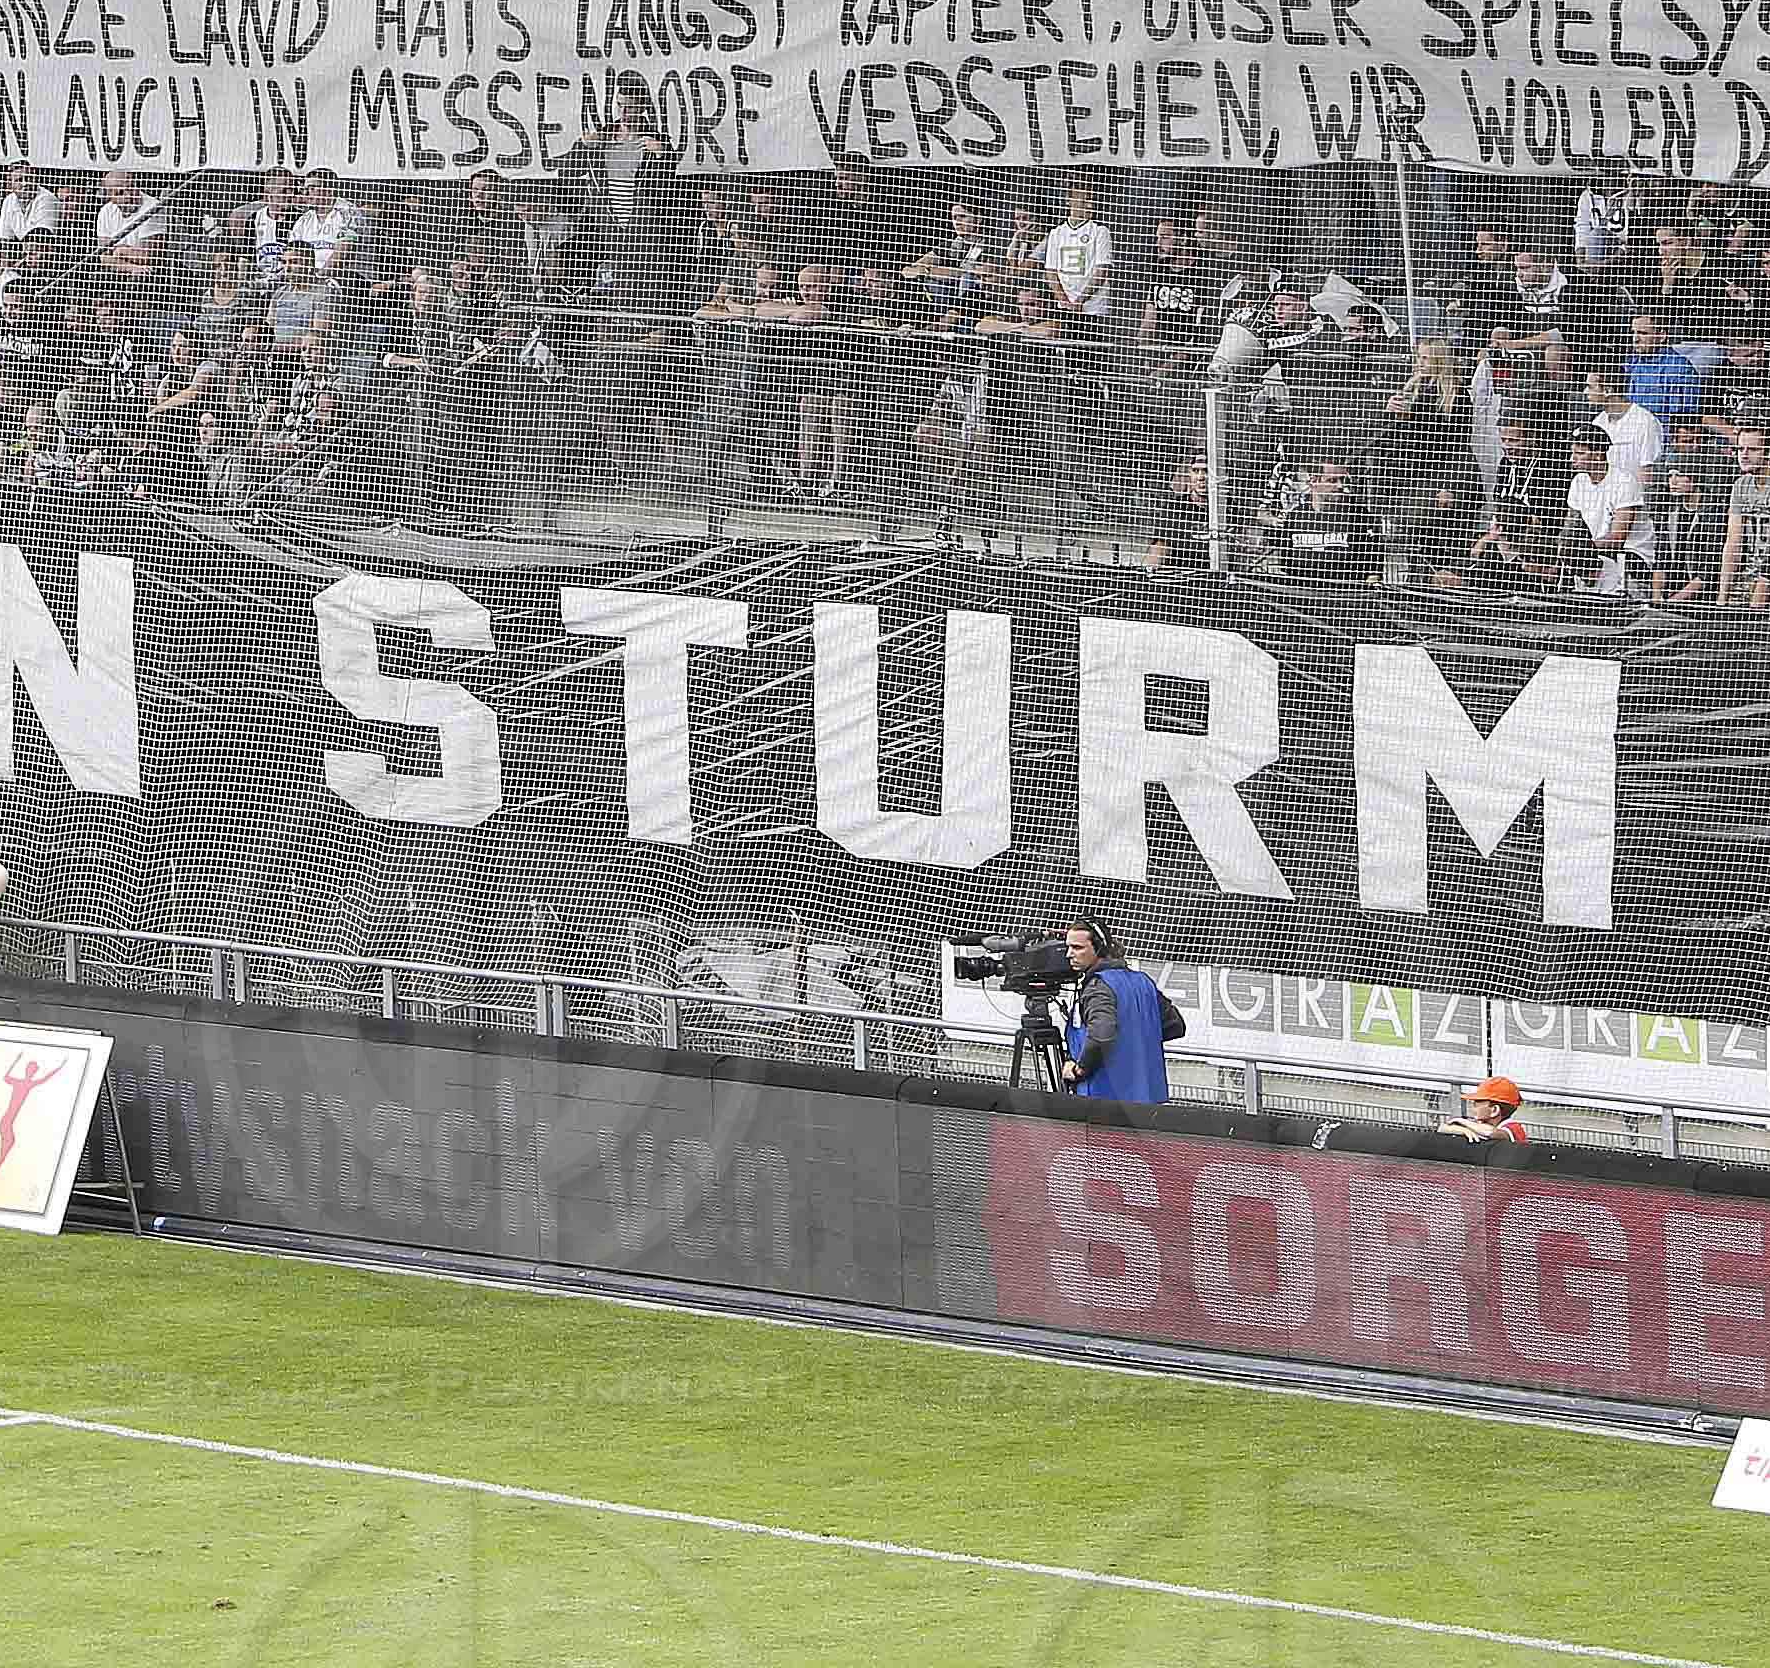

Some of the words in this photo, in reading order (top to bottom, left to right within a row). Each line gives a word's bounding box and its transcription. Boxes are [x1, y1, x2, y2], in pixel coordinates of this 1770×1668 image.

[61, 73, 208, 167] AUCH
[251, 76, 308, 171] IN
[807, 57, 1280, 167] VERSTEHEN,
[1300, 61, 1431, 163] WIR
[1462, 67, 1697, 175] WOLLEN
[312, 572, 1622, 930] STURM
